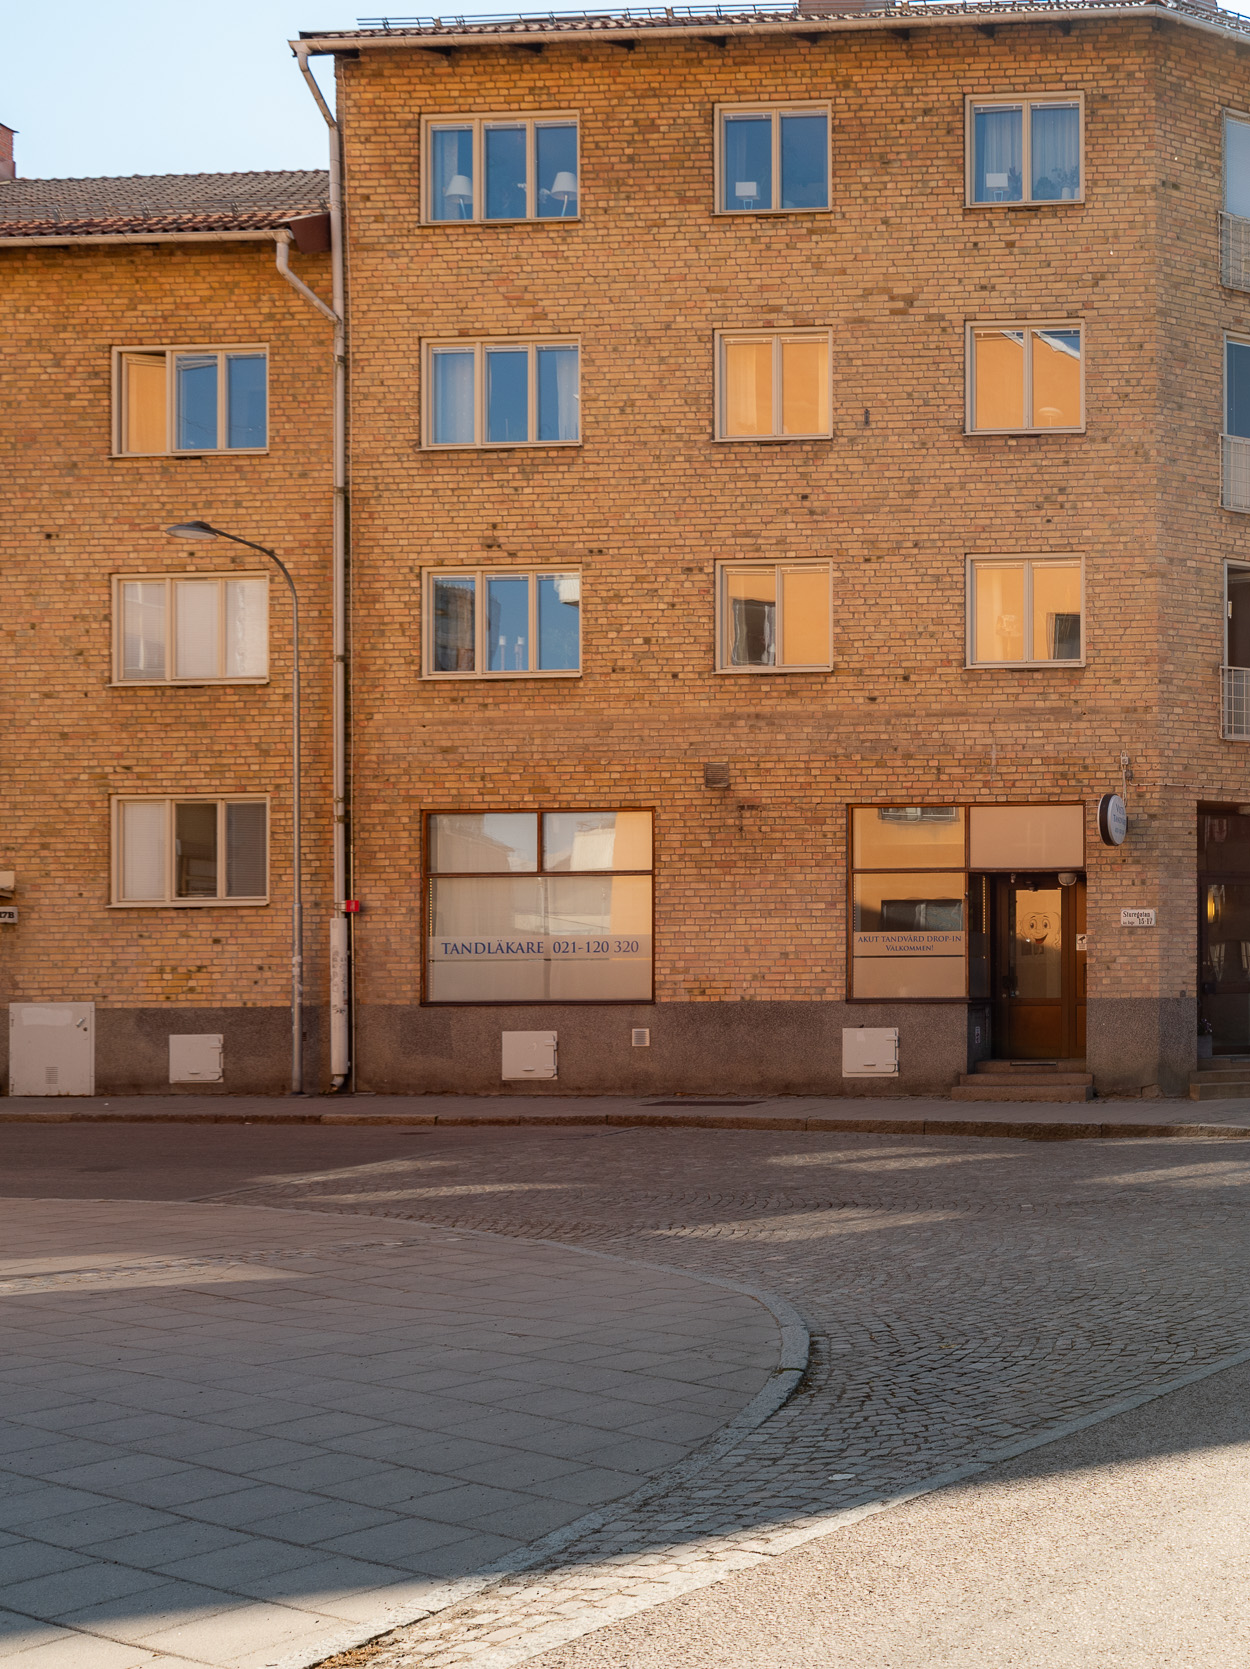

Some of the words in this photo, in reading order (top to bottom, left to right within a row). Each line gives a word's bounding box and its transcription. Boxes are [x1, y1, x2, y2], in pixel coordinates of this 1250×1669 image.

[881, 934, 924, 942] TANDVÅRD
[441, 939, 544, 955] TANDLÄKARE
[553, 940, 610, 954] 021-120
[614, 940, 639, 953] 320
